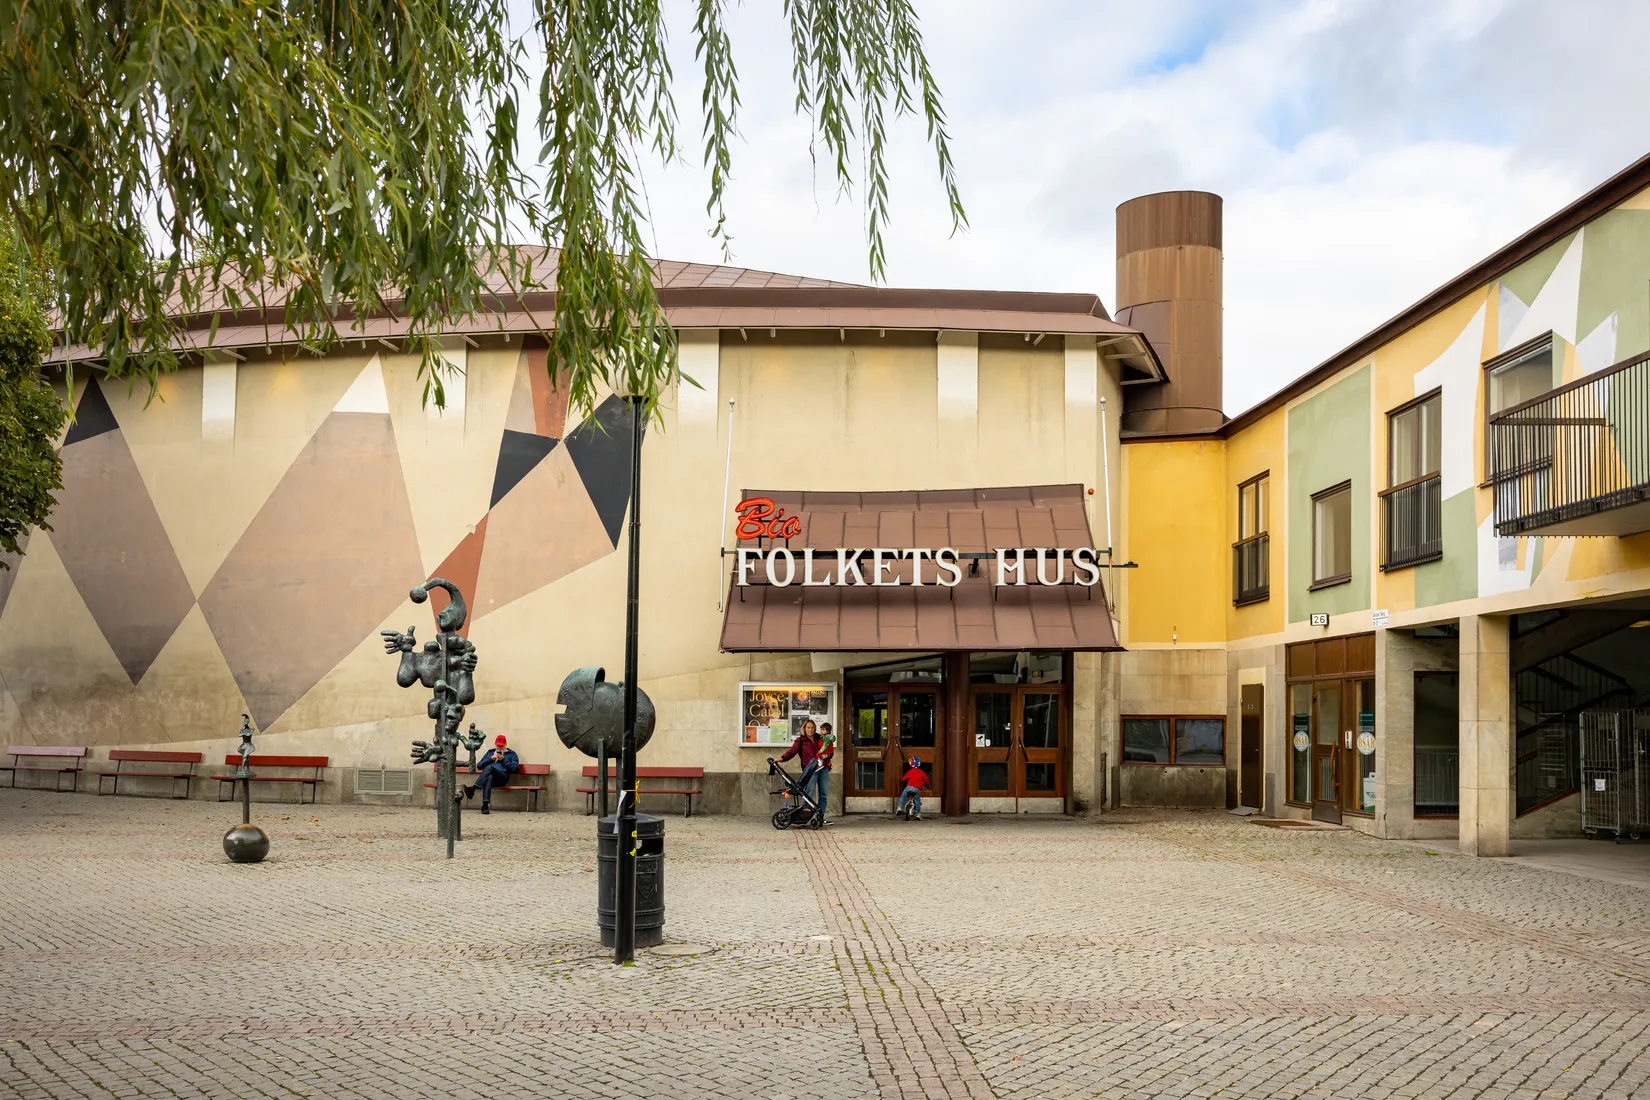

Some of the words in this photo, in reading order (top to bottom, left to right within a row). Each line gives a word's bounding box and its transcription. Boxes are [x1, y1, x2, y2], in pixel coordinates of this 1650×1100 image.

[735, 497, 802, 540] Bio
[736, 547, 962, 588] FOLKETS
[994, 546, 1100, 587] HUS
[1313, 615, 1326, 624] 26
[749, 689, 785, 705] Joyce
